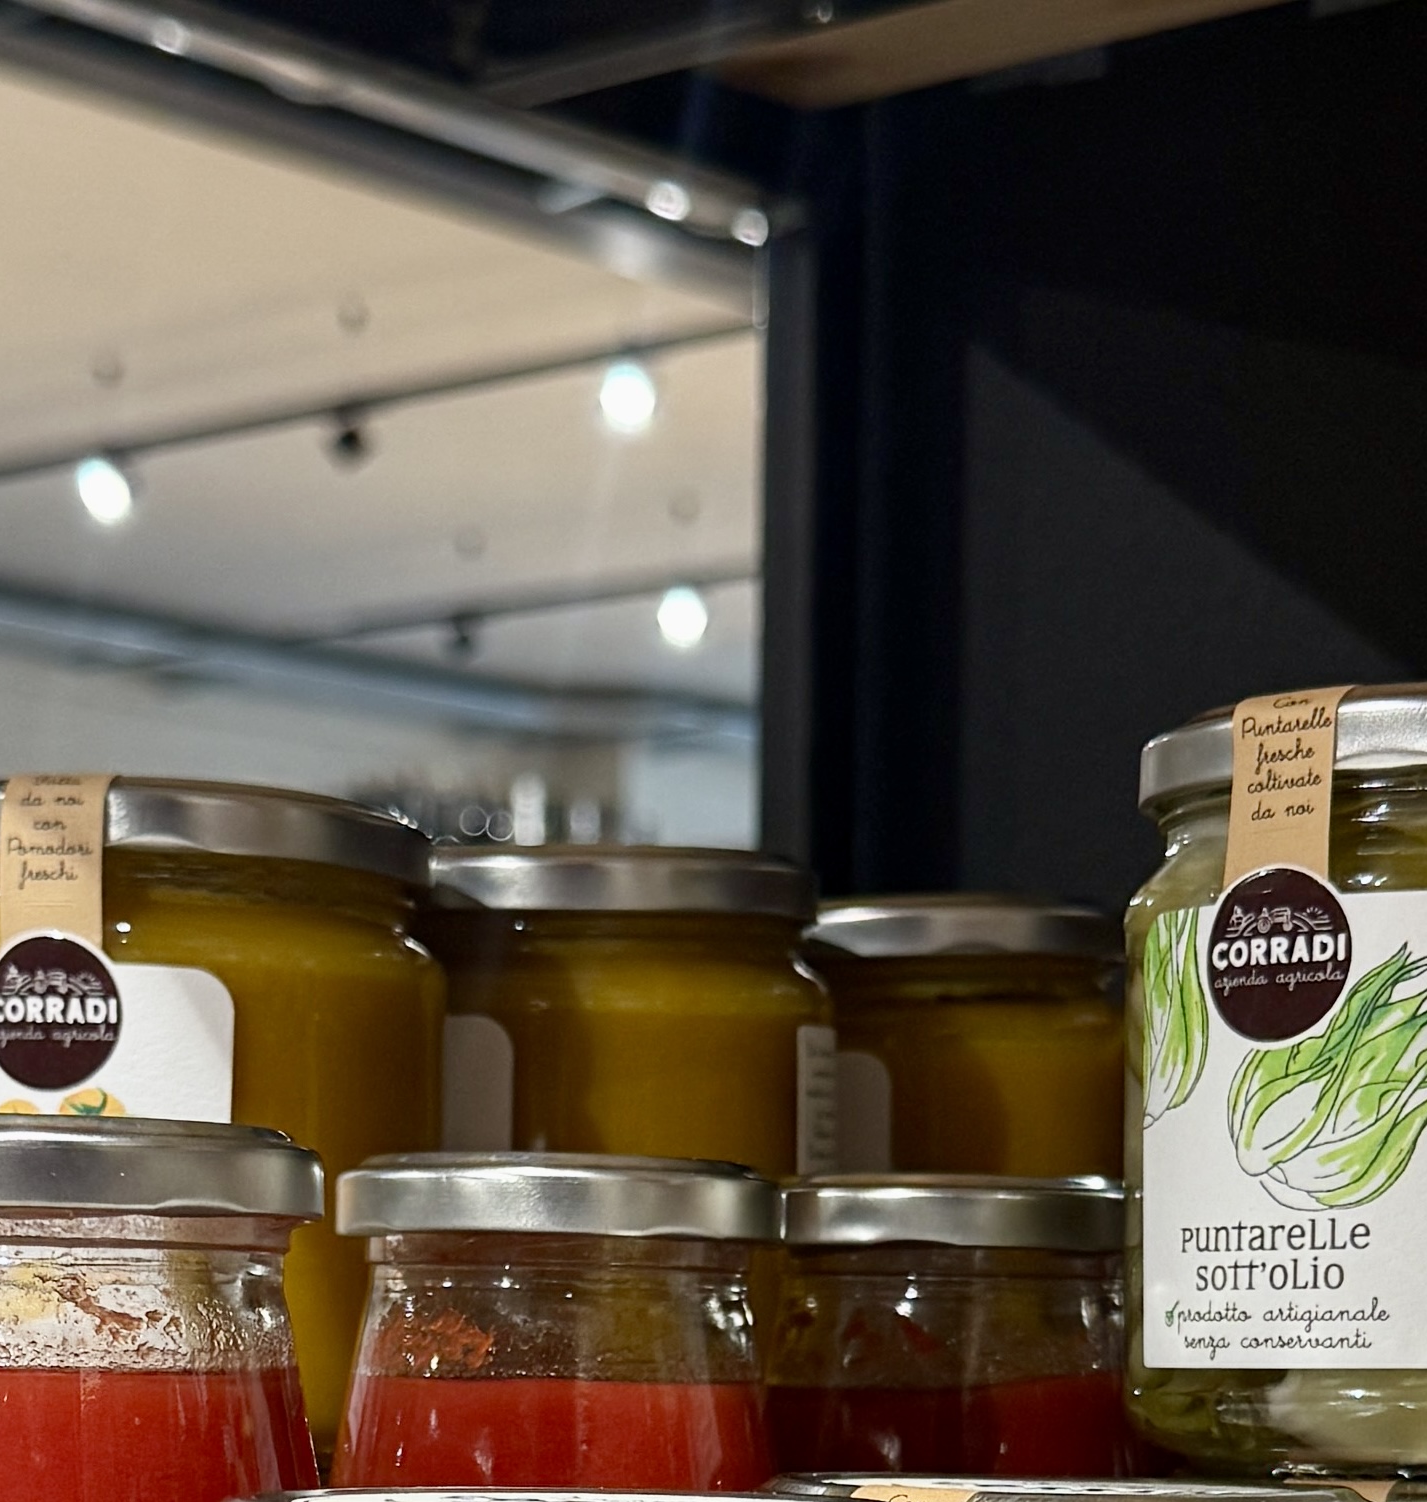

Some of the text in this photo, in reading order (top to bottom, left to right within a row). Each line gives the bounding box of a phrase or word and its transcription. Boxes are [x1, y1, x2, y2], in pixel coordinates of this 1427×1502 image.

[1241, 707, 1332, 739] Puntarelle
[1254, 738, 1315, 775] fresche
[1247, 767, 1322, 794] coltivate
[1251, 800, 1314, 822] da noi
[1211, 932, 1347, 970] CORRADI
[1214, 961, 1345, 996] azienda agricola
[1177, 1296, 1390, 1335] prodotto artigianale
[1184, 1328, 1373, 1360] senza conservanti
